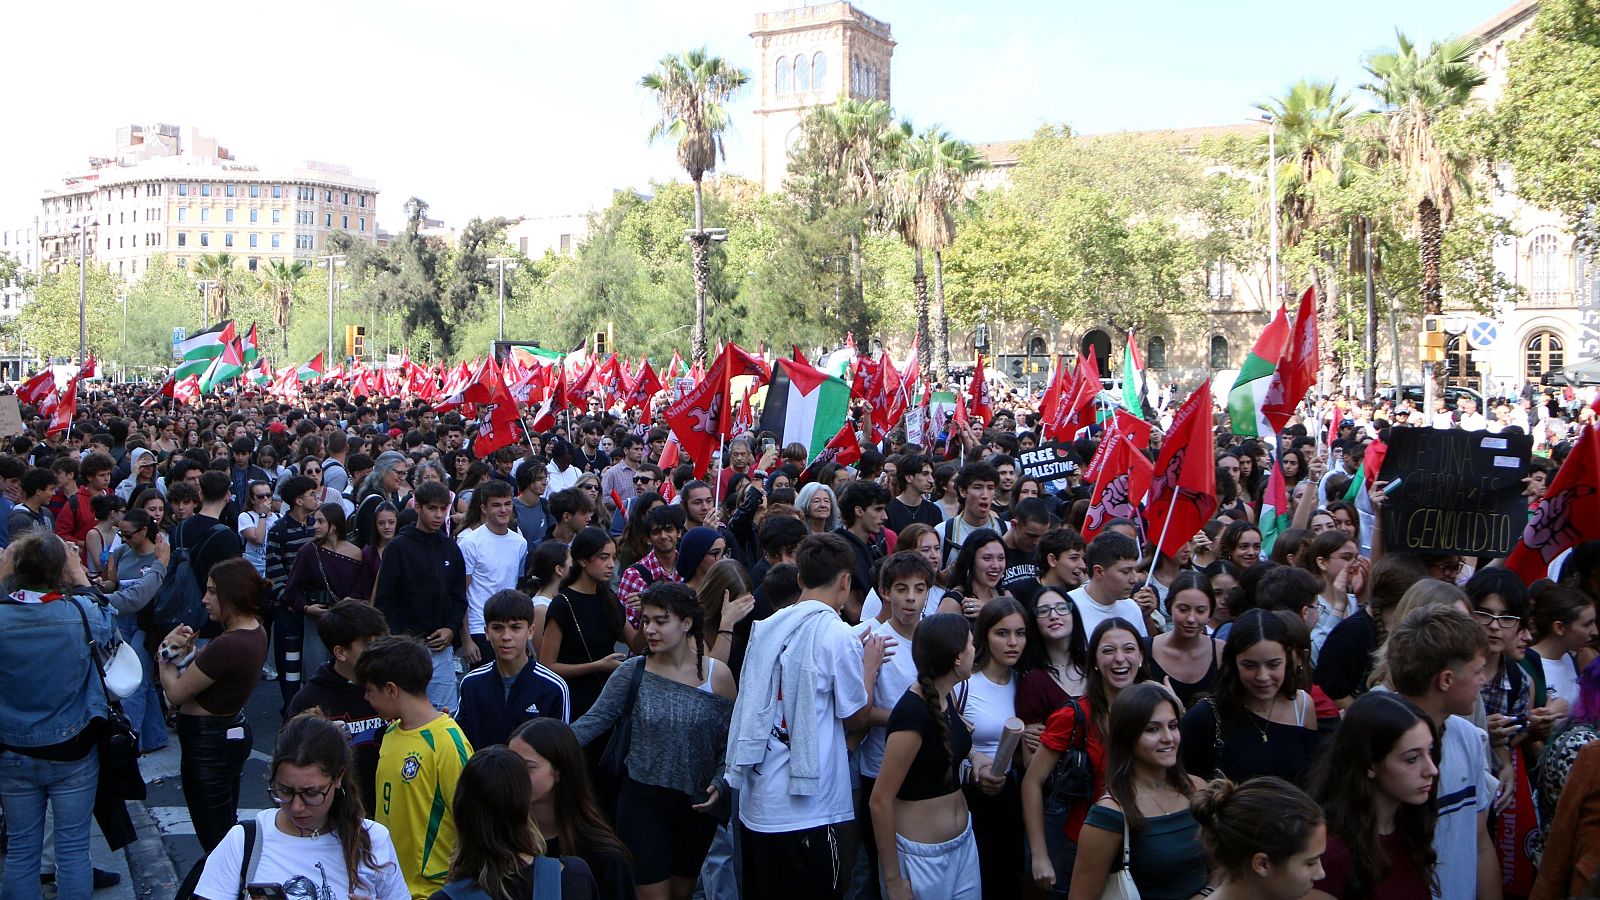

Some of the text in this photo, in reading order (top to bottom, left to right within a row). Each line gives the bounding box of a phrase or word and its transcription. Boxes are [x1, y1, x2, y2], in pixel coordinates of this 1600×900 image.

[666, 390, 702, 419] Sindicat
[1020, 447, 1055, 465] FREE
[1023, 460, 1075, 479] PALESTINE
[1083, 452, 1101, 479] Sindicat
[1406, 507, 1511, 553] GENOCIDIO
[383, 781, 392, 816] 9
